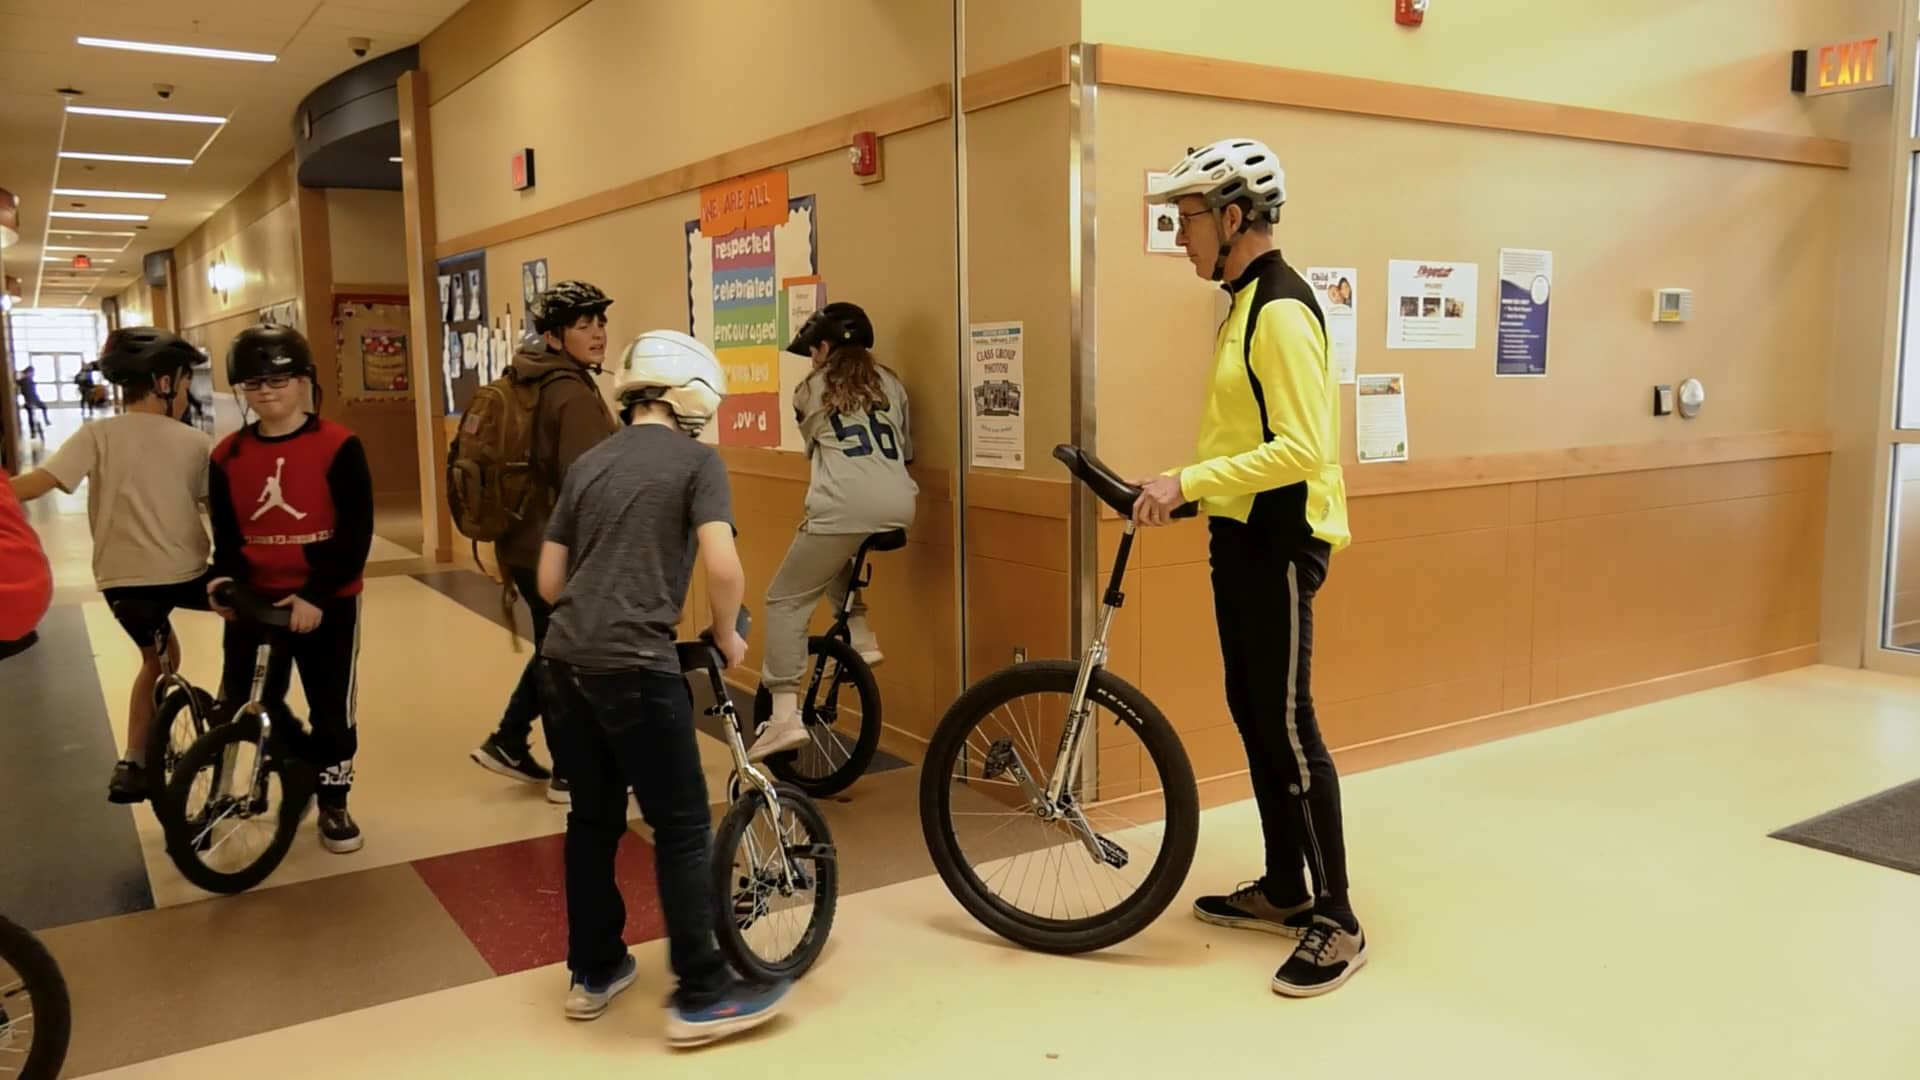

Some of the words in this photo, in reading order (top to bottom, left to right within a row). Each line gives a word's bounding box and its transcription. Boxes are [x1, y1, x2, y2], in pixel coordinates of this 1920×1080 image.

[1819, 38, 1879, 87] EXIT
[703, 198, 720, 223] WE
[724, 190, 744, 214] ARE
[748, 182, 770, 209] ALL
[715, 232, 771, 259] respected
[714, 277, 774, 301] celebrated
[714, 320, 776, 344] encouraged
[976, 349, 994, 362] CLASS
[830, 408, 899, 460] 56
[1097, 688, 1144, 725] KENDA
